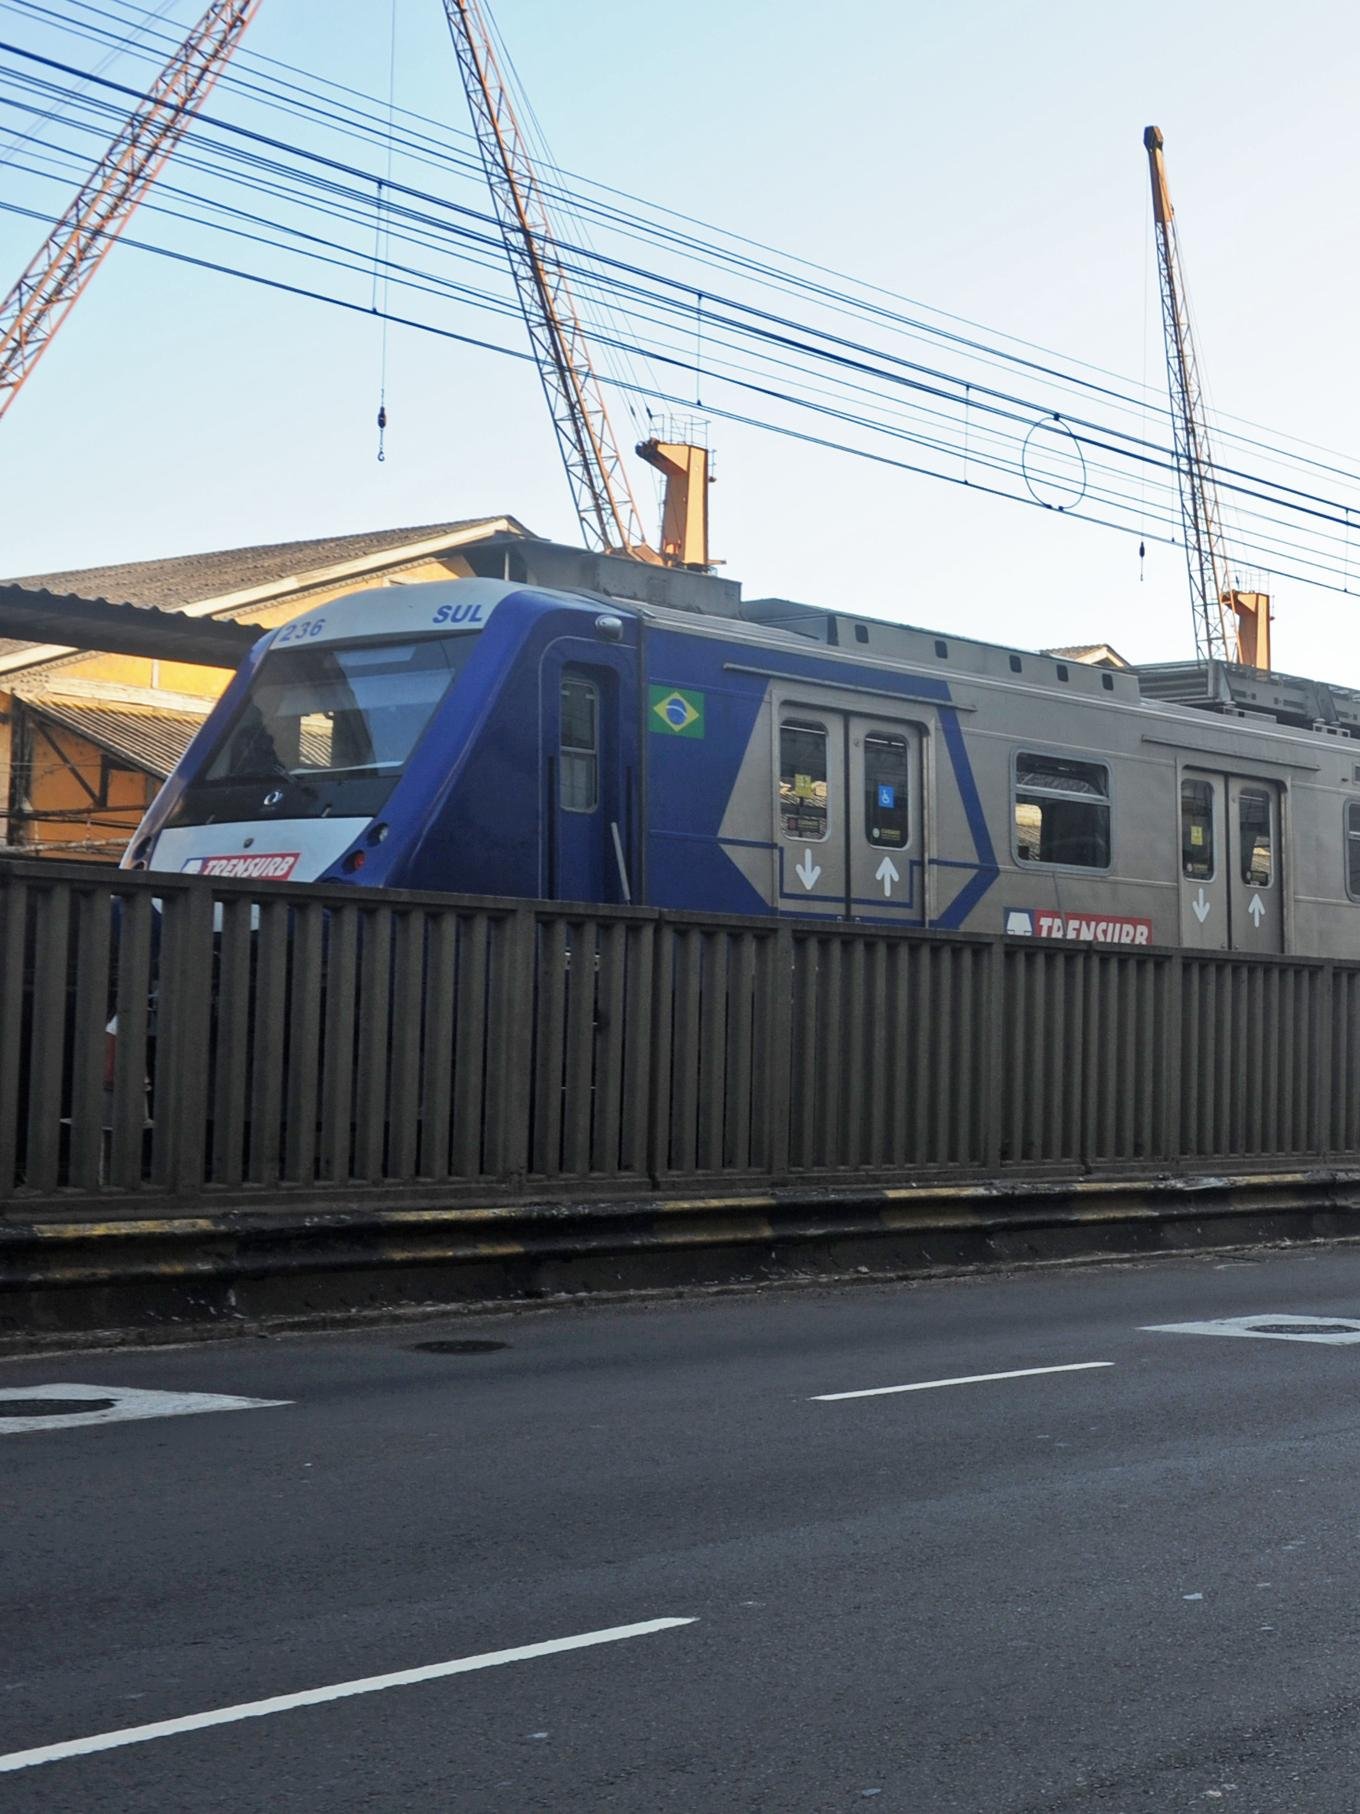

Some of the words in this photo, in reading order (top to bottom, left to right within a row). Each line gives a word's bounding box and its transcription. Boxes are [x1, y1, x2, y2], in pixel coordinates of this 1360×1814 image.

[432, 604, 483, 624] SUL
[279, 618, 326, 642] 236
[202, 856, 295, 878] TRENSURB
